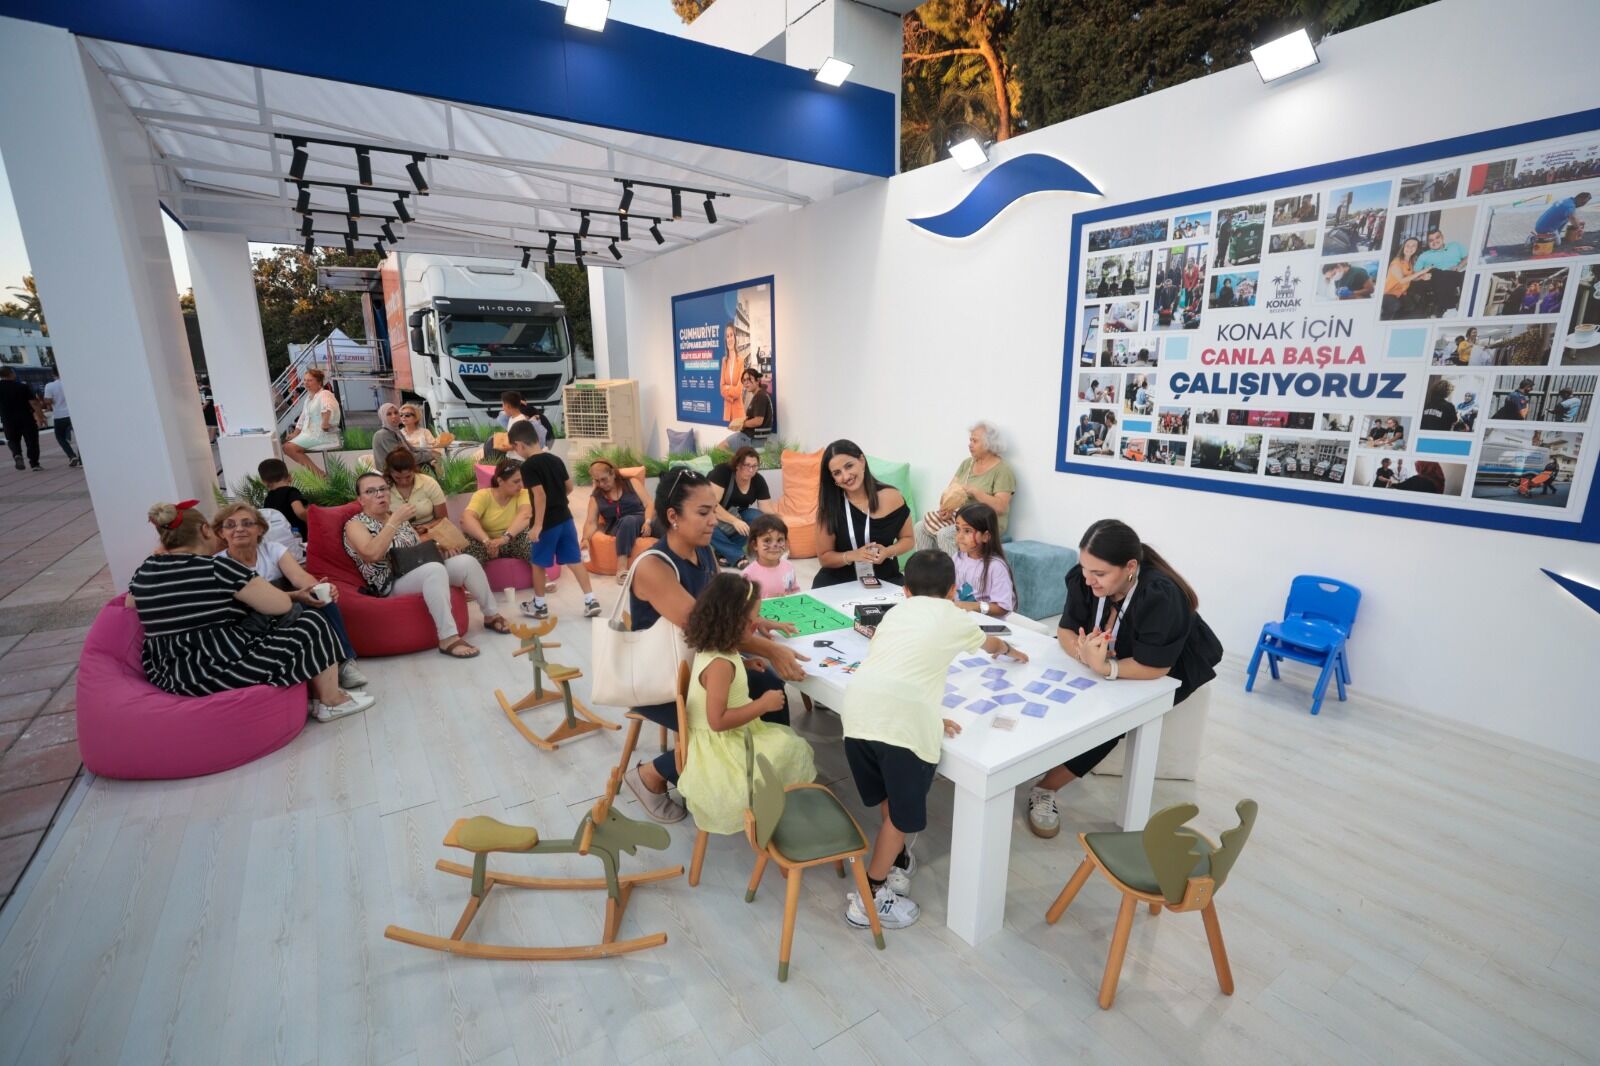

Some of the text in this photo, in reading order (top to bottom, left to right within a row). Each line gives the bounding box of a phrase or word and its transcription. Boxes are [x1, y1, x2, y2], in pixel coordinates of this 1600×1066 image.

[1266, 298, 1302, 309] KONAK
[679, 322, 720, 340] CUMHURİYET
[1217, 315, 1353, 342] KONAK İÇİN
[1201, 345, 1366, 368] CANLA BAŞLA
[458, 364, 489, 374] AFAD
[1169, 372, 1407, 402] ÇALIŞIYORUZ
